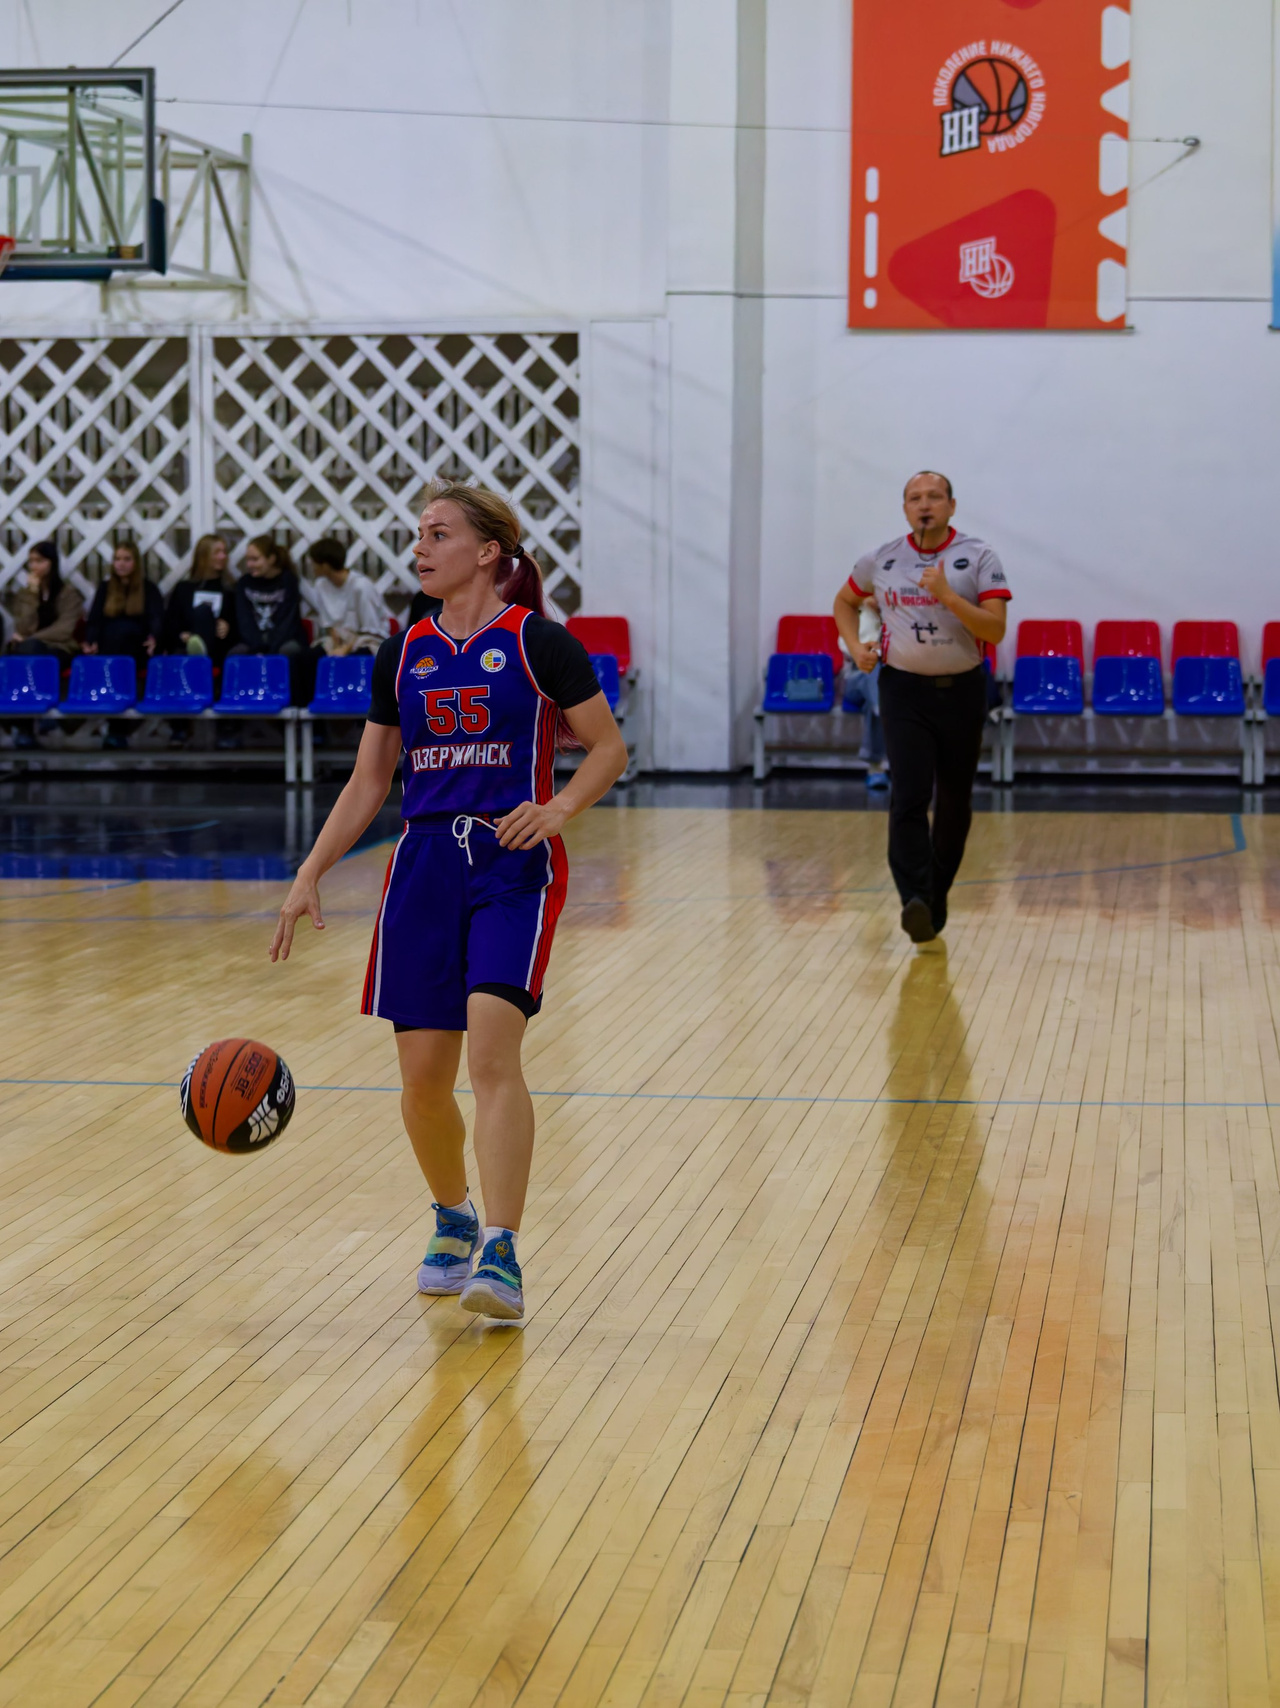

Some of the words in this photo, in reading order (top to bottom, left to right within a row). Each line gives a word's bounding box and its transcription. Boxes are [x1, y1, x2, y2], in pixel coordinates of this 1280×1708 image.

[932, 39, 987, 106] ПОКОЛЕНИЕ
[990, 39, 1045, 89] НИЖНЕГО
[986, 91, 1046, 154] НОВГОРОДА
[419, 685, 490, 737] 55
[410, 742, 511, 772] ДЗЕРЖИНСК
[235, 1051, 263, 1098] JB-500
